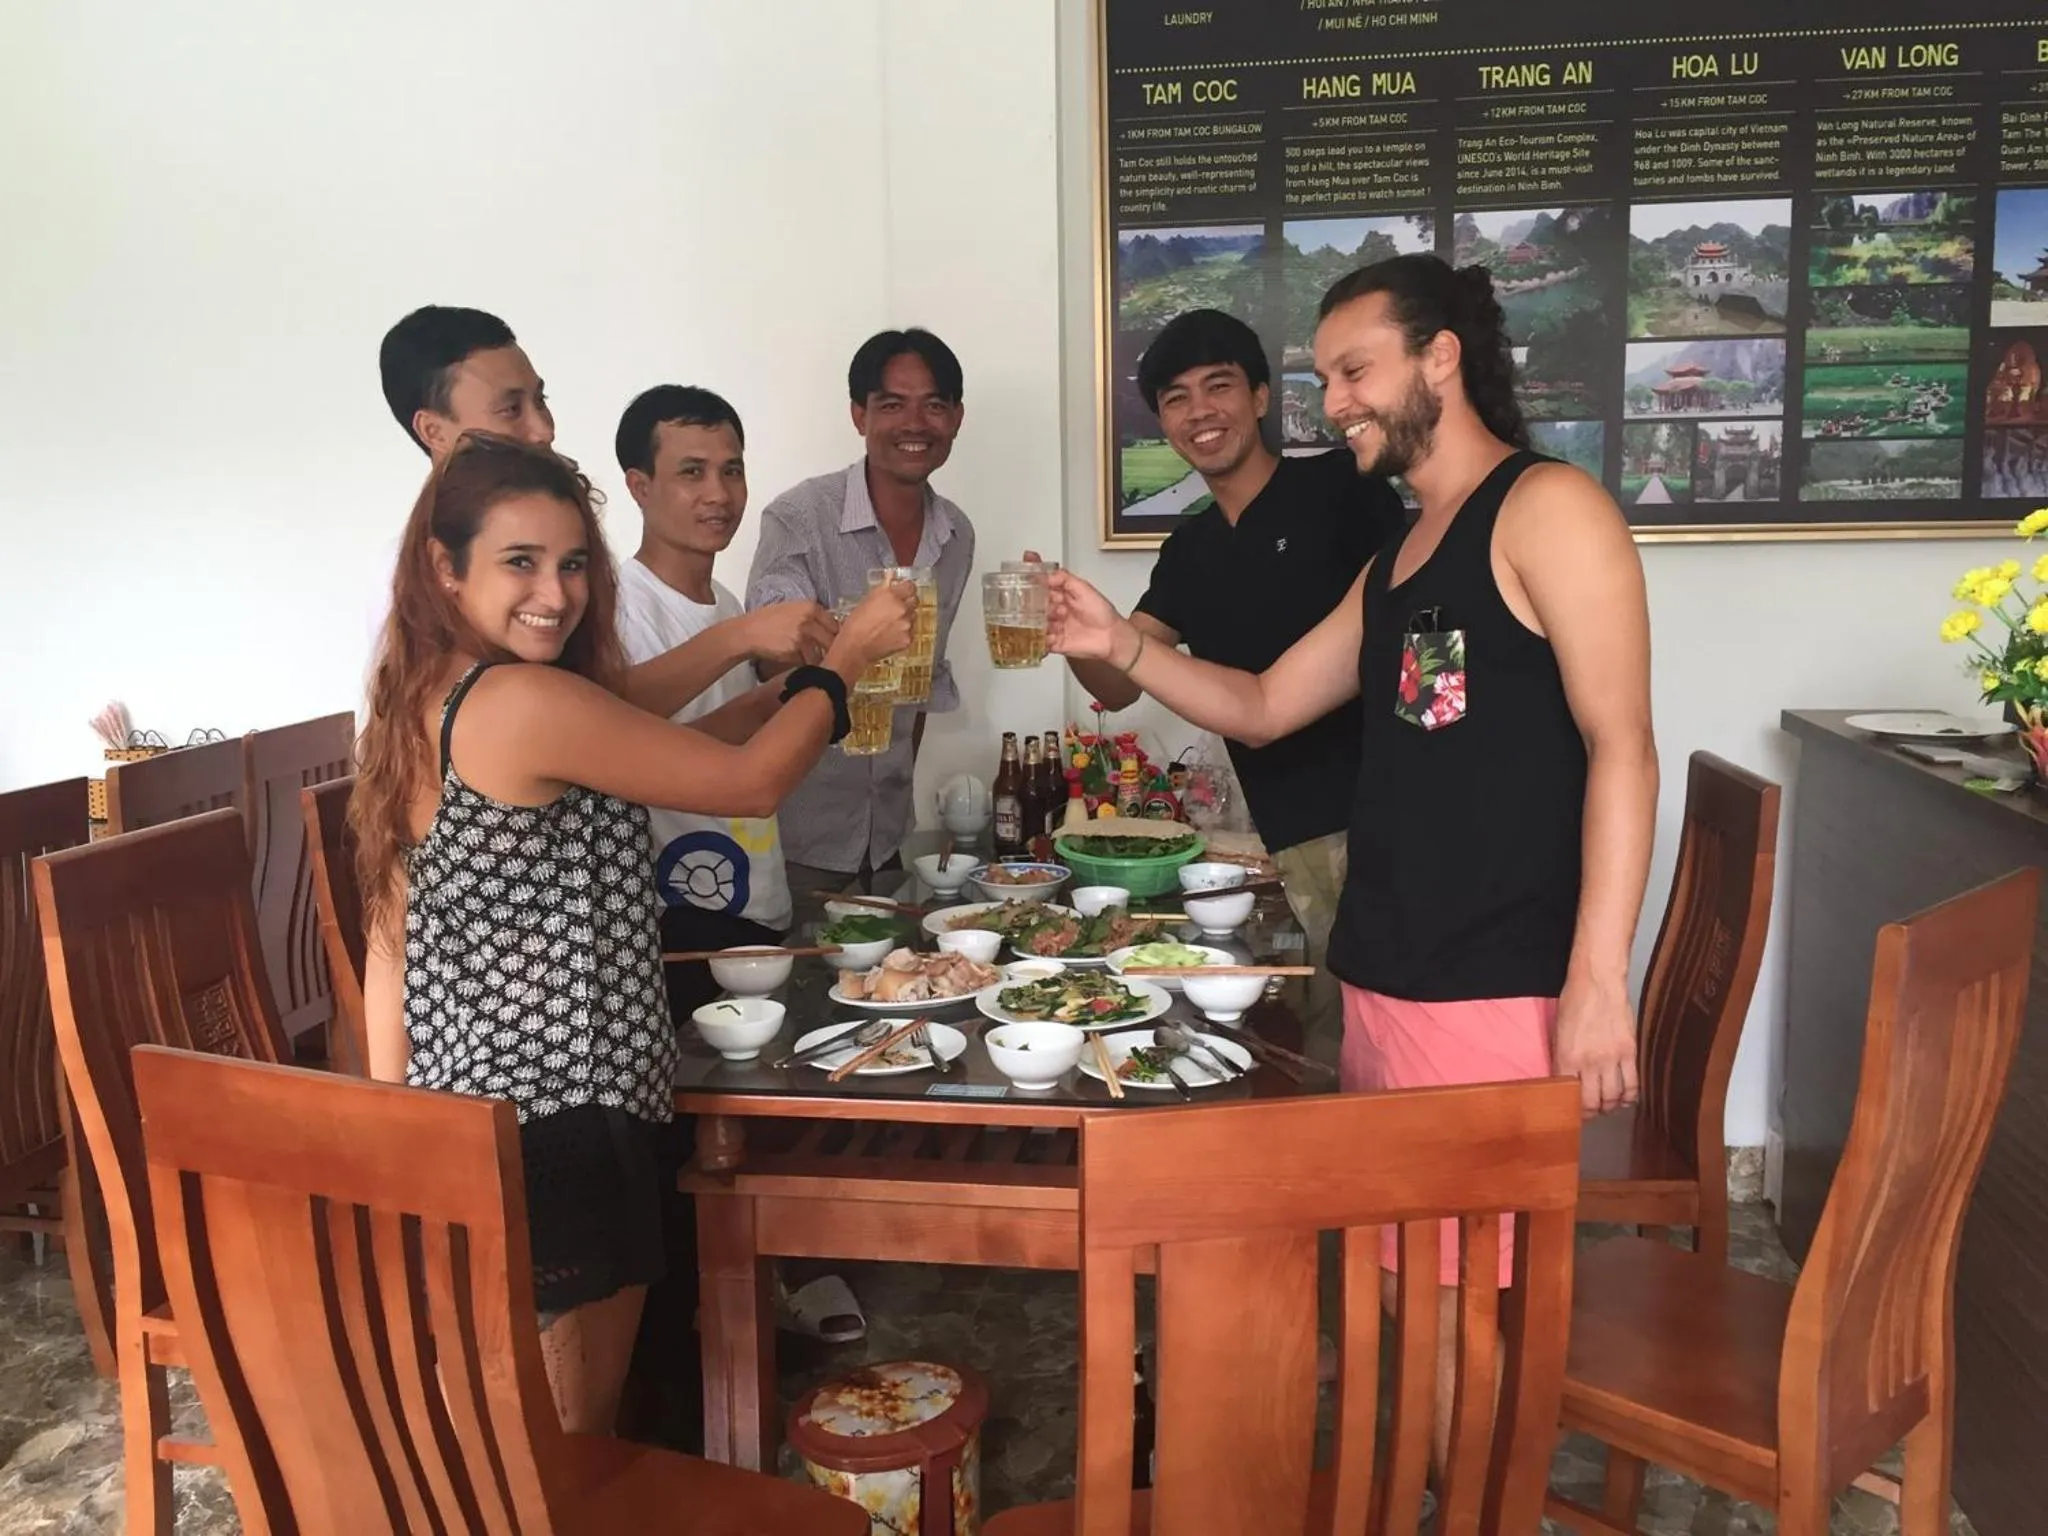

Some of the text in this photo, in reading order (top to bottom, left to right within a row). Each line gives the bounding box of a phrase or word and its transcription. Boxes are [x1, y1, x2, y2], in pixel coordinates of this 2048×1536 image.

[1165, 12, 1212, 25] LAUNDRY
[1326, 18, 1344, 29] MUI
[1389, 14, 1407, 25] CHI
[1410, 13, 1437, 24] MINH
[1841, 44, 1958, 69] VAN LONG
[1673, 53, 1758, 78] HOA LU
[1479, 61, 1592, 88] TRANG AN
[1142, 80, 1237, 104] TAM COC
[1304, 72, 1416, 99] HANG MUA
[1882, 88, 1909, 97] FROM
[1912, 87, 1931, 96] TAM
[1933, 86, 1953, 96] COC
[1698, 96, 1725, 106] FROM
[1727, 95, 1746, 104] TAM
[1748, 94, 1767, 104] COC
[1518, 106, 1544, 115] FROM
[1547, 105, 1566, 114] TAM
[1568, 103, 1586, 113] COC
[1342, 116, 1367, 126] FROM
[1369, 114, 1387, 124] TAM
[1389, 113, 1407, 124] COC
[1817, 122, 1833, 130] Van
[1836, 122, 1859, 132] Long
[1861, 119, 1896, 129] Natural
[1942, 117, 1972, 125] known
[1147, 128, 1171, 137] FROM
[1174, 128, 1191, 136] TAM
[1193, 126, 1210, 136] COC
[1213, 124, 1262, 135] BUNGALOW
[1635, 125, 1788, 138] Hoa Lu was capital city of Vietnam
[1458, 139, 1483, 149] Trang
[1485, 138, 1496, 146] An
[1829, 136, 1844, 146] the
[1902, 134, 1934, 142] Nature
[1967, 131, 1976, 140] of
[1303, 148, 1325, 158] steps
[1327, 146, 1345, 155] lead
[1348, 147, 1363, 156] you
[1383, 143, 1412, 153] temple
[1414, 143, 1425, 151] on
[1635, 140, 1780, 154] under the Dinh Dynasty between
[2001, 145, 2025, 155] Quan
[1119, 153, 1257, 167] Tam Coc still holds the untouched
[1504, 151, 1530, 161] World
[1533, 151, 1571, 161] Heritage
[1573, 148, 1590, 158] Site
[1816, 152, 1837, 162] Ninh
[1866, 151, 1887, 160] With
[1914, 149, 1954, 159] hectares
[1956, 147, 1965, 156] of
[1286, 164, 1299, 174] top
[1301, 162, 1310, 172] of
[1337, 161, 1351, 170] the
[1353, 159, 1403, 170] spectacular
[1634, 160, 1650, 170] 968
[1652, 160, 1669, 169] and
[1697, 158, 1723, 167] Some
[1725, 156, 1735, 166] of
[1737, 156, 1751, 165] the
[1120, 174, 1146, 182] nature
[1457, 171, 1479, 179] since
[1482, 168, 1503, 178] June
[1531, 166, 1539, 175] is
[1548, 164, 1593, 174] must-visit
[1815, 167, 1857, 177] wetlands
[1886, 165, 1932, 177] legendary
[1286, 178, 1306, 187] from
[1308, 178, 1330, 188] Hang
[1332, 176, 1350, 185] Mua
[1352, 176, 1370, 185] over
[1373, 174, 1391, 183] Tam
[1393, 173, 1409, 182] Coc
[1668, 174, 1684, 184] and
[1717, 173, 1738, 181] have
[1120, 182, 1256, 198] the simplicity and rustic charm of
[1457, 184, 1505, 194] destination
[1507, 183, 1516, 191] in
[1518, 182, 1539, 190] Ninh
[1286, 188, 1425, 204] the perfect place to watch sunset
[1120, 203, 1151, 213] country
